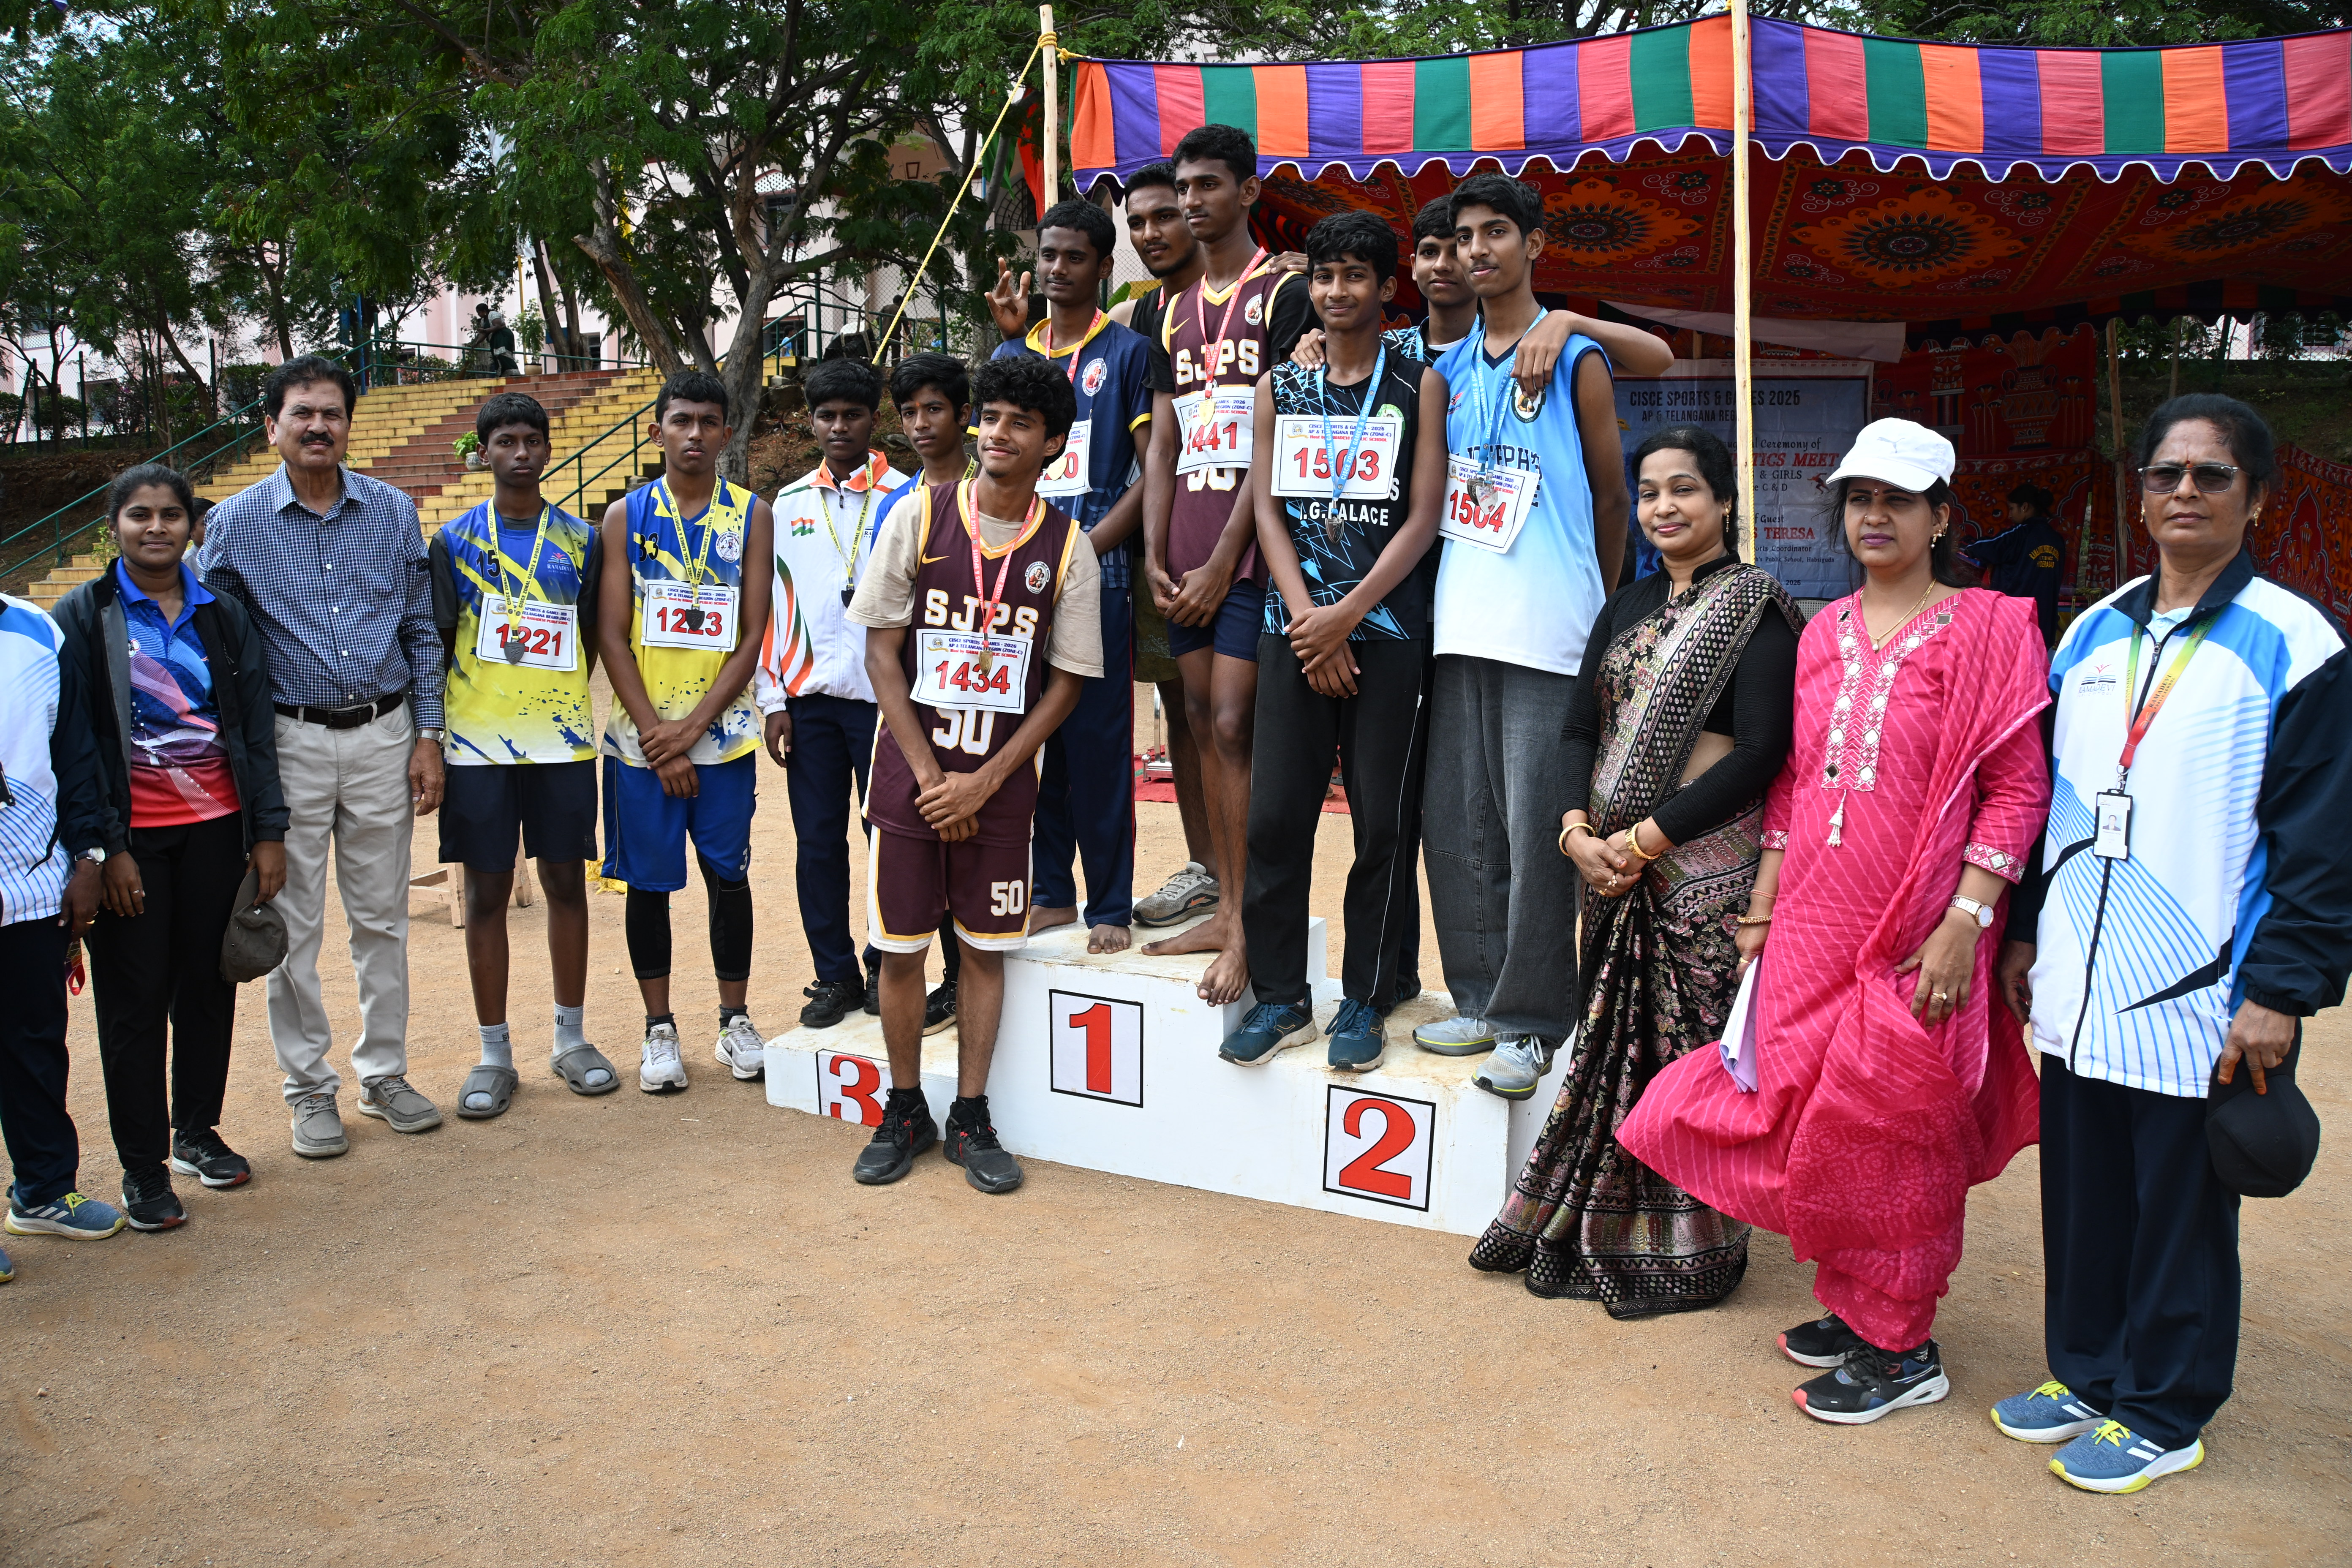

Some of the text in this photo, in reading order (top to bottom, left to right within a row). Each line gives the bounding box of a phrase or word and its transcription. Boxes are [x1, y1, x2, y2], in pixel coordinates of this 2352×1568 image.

[1240, 257, 1259, 280] CISCE ZONAL
[1228, 292, 1236, 310] SPORTS
[1372, 372, 1380, 387] CISCE
[1502, 392, 1510, 411] GAMES
[1630, 390, 1800, 406] CISCE SPORTS & 2026
[1642, 410, 1715, 422] AP TELANGANA
[1341, 464, 1350, 480] CISCE
[1346, 446, 1356, 466] ZONAL
[1353, 427, 1362, 445] GAMES
[1361, 400, 1371, 420] SPORTS
[1760, 439, 1808, 452] Ceremony
[1811, 437, 1821, 450] of
[1294, 447, 1380, 481] 1503
[1792, 453, 1840, 467] MEET
[1760, 470, 1767, 479] &
[1772, 470, 1802, 480] GIRLS
[1503, 482, 1519, 490] (ZONE-C)
[1762, 483, 1768, 491] C
[1781, 483, 1788, 491] D
[1760, 514, 1784, 524] Guest
[1764, 527, 1816, 539] TERESA
[476, 549, 501, 579] 15
[547, 564, 572, 572] RAMADEVI
[1807, 556, 1835, 564] Habsiguda
[995, 567, 1007, 599] CISCE ZONAL
[925, 588, 1039, 639] SJPS
[495, 623, 562, 656] 1221
[935, 660, 1010, 694] 1434
[2079, 684, 2115, 694] RAMADEVI
[2148, 674, 2172, 708] RAMADEVI
[2154, 677, 2176, 710] PUBLIC SCHOOL
[991, 879, 1024, 916] 50
[1069, 1002, 1112, 1094] 1
[829, 1054, 883, 1127] 3
[1339, 1098, 1416, 1200] 2
